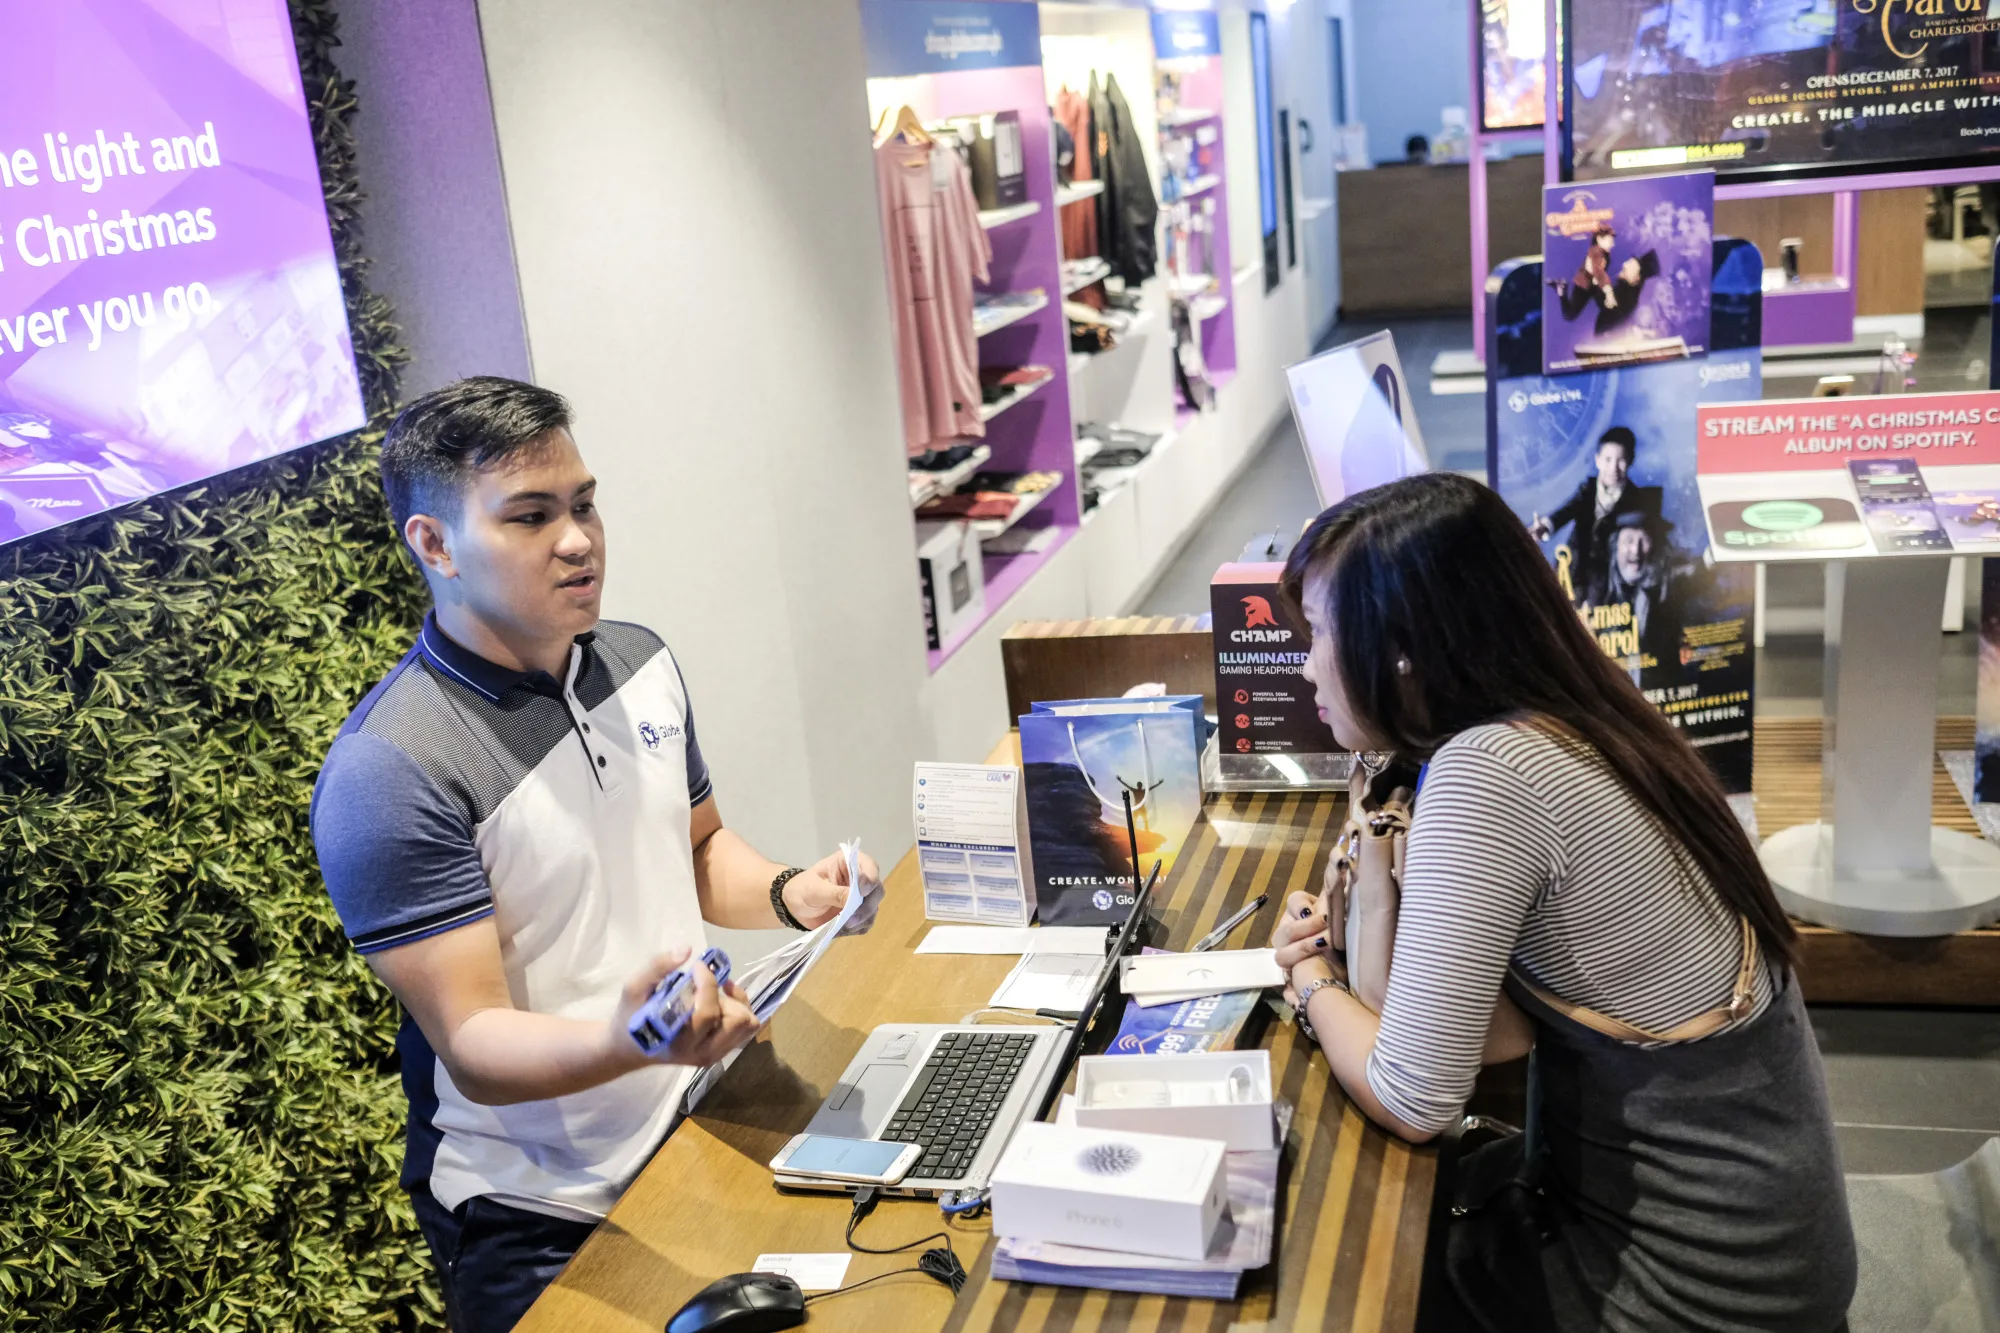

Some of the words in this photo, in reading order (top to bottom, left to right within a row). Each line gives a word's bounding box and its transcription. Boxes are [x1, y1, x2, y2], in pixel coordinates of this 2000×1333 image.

[1909, 25, 1962, 39] CHARLES
[1806, 73, 1849, 89] OPENS
[1852, 68, 1922, 85] DECEMBER
[1935, 65, 1959, 78] 2017
[1747, 93, 1788, 106] GLOBE
[1792, 89, 1838, 102] ICONIC
[1731, 111, 1811, 129] CREATE.
[1817, 106, 1854, 121] THE
[1862, 99, 1946, 118] MIRACLE
[1953, 95, 2000, 110] WITH
[1960, 127, 1983, 137] Book
[44, 128, 146, 193] light
[152, 121, 221, 173] and
[16, 206, 217, 268] Christmas
[0, 306, 70, 357] ver
[79, 290, 157, 351] you
[162, 281, 223, 333] go.
[1704, 414, 1796, 438] STREAM
[1799, 415, 1838, 432] THE
[1867, 408, 1981, 430] CHRISTMAS
[1984, 407, 2000, 424] C
[1783, 436, 1853, 455] ALBUM
[1856, 434, 1888, 451] ON
[1892, 431, 1977, 450] SPOTIFY.
[1575, 601, 1632, 630] tmas
[1230, 629, 1293, 643] CHAMP
[1597, 614, 1640, 659] arol
[1218, 652, 1309, 664] ILLUMINATED
[1219, 665, 1252, 675] GAMING
[1684, 705, 1746, 726] WITHIN.
[659, 724, 681, 739] Globe
[1048, 875, 1102, 886] CREATE.
[1104, 875, 1167, 885] WONDR
[1115, 894, 1135, 905] Glo
